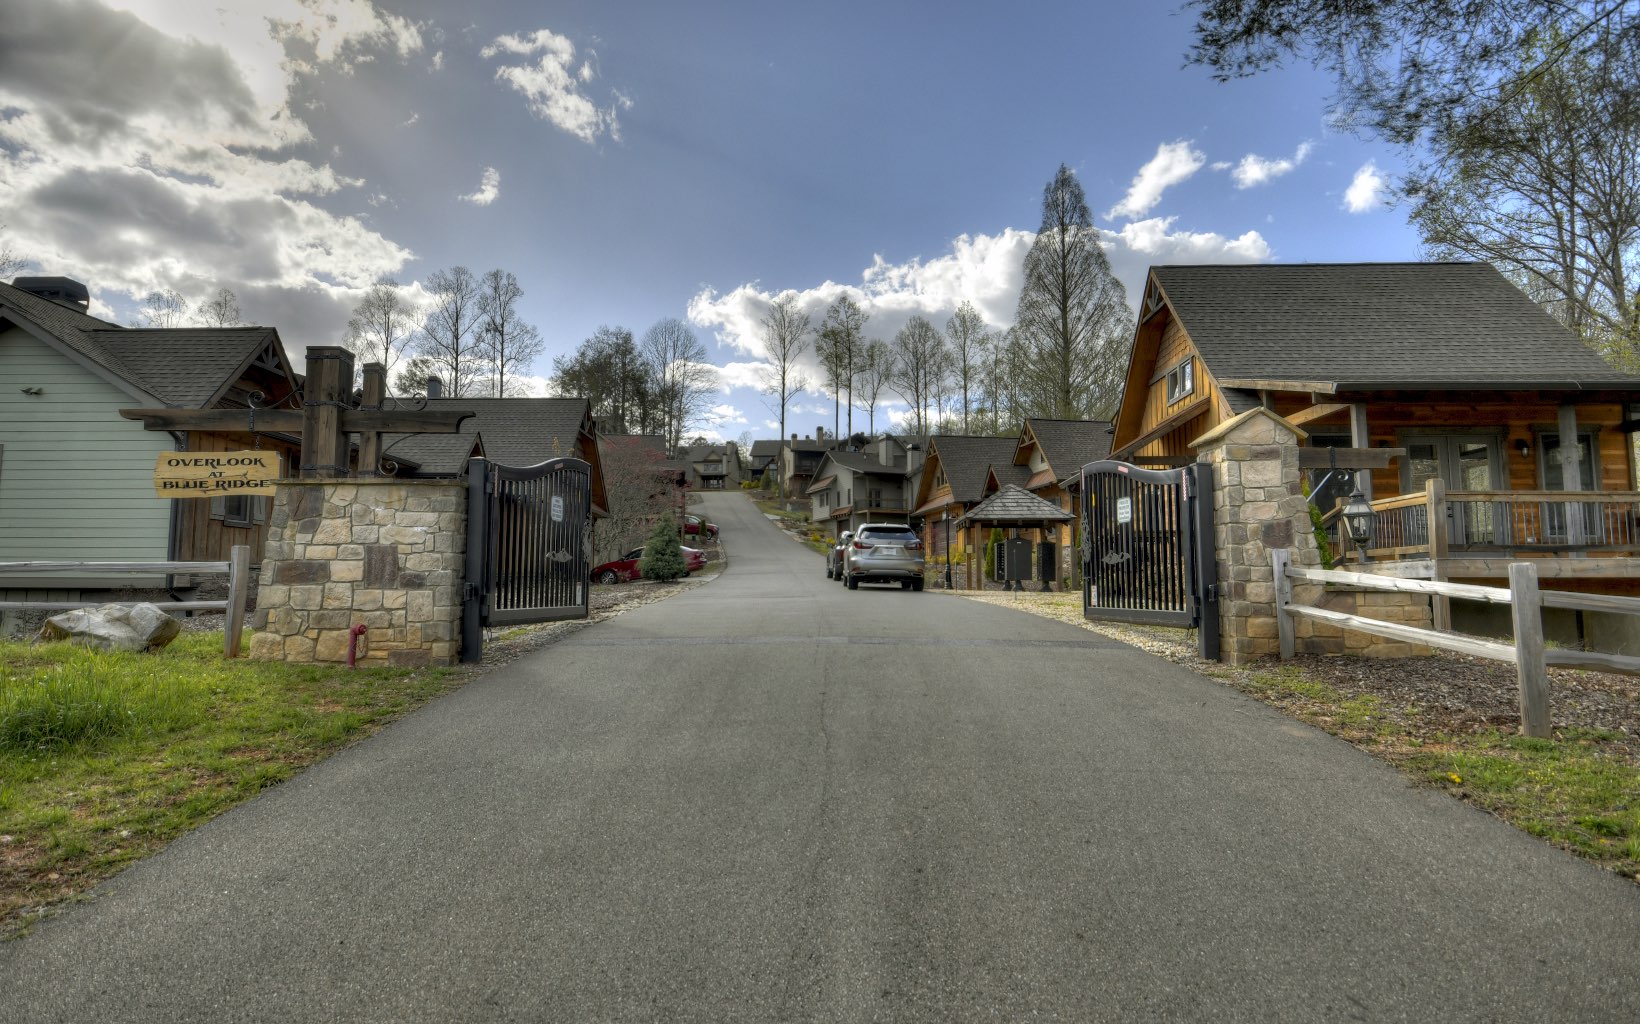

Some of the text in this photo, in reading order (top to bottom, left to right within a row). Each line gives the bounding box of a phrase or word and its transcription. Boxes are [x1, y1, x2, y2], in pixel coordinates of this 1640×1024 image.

[167, 457, 266, 469] OVERLOOK
[163, 479, 270, 491] BLUE RIDGE
